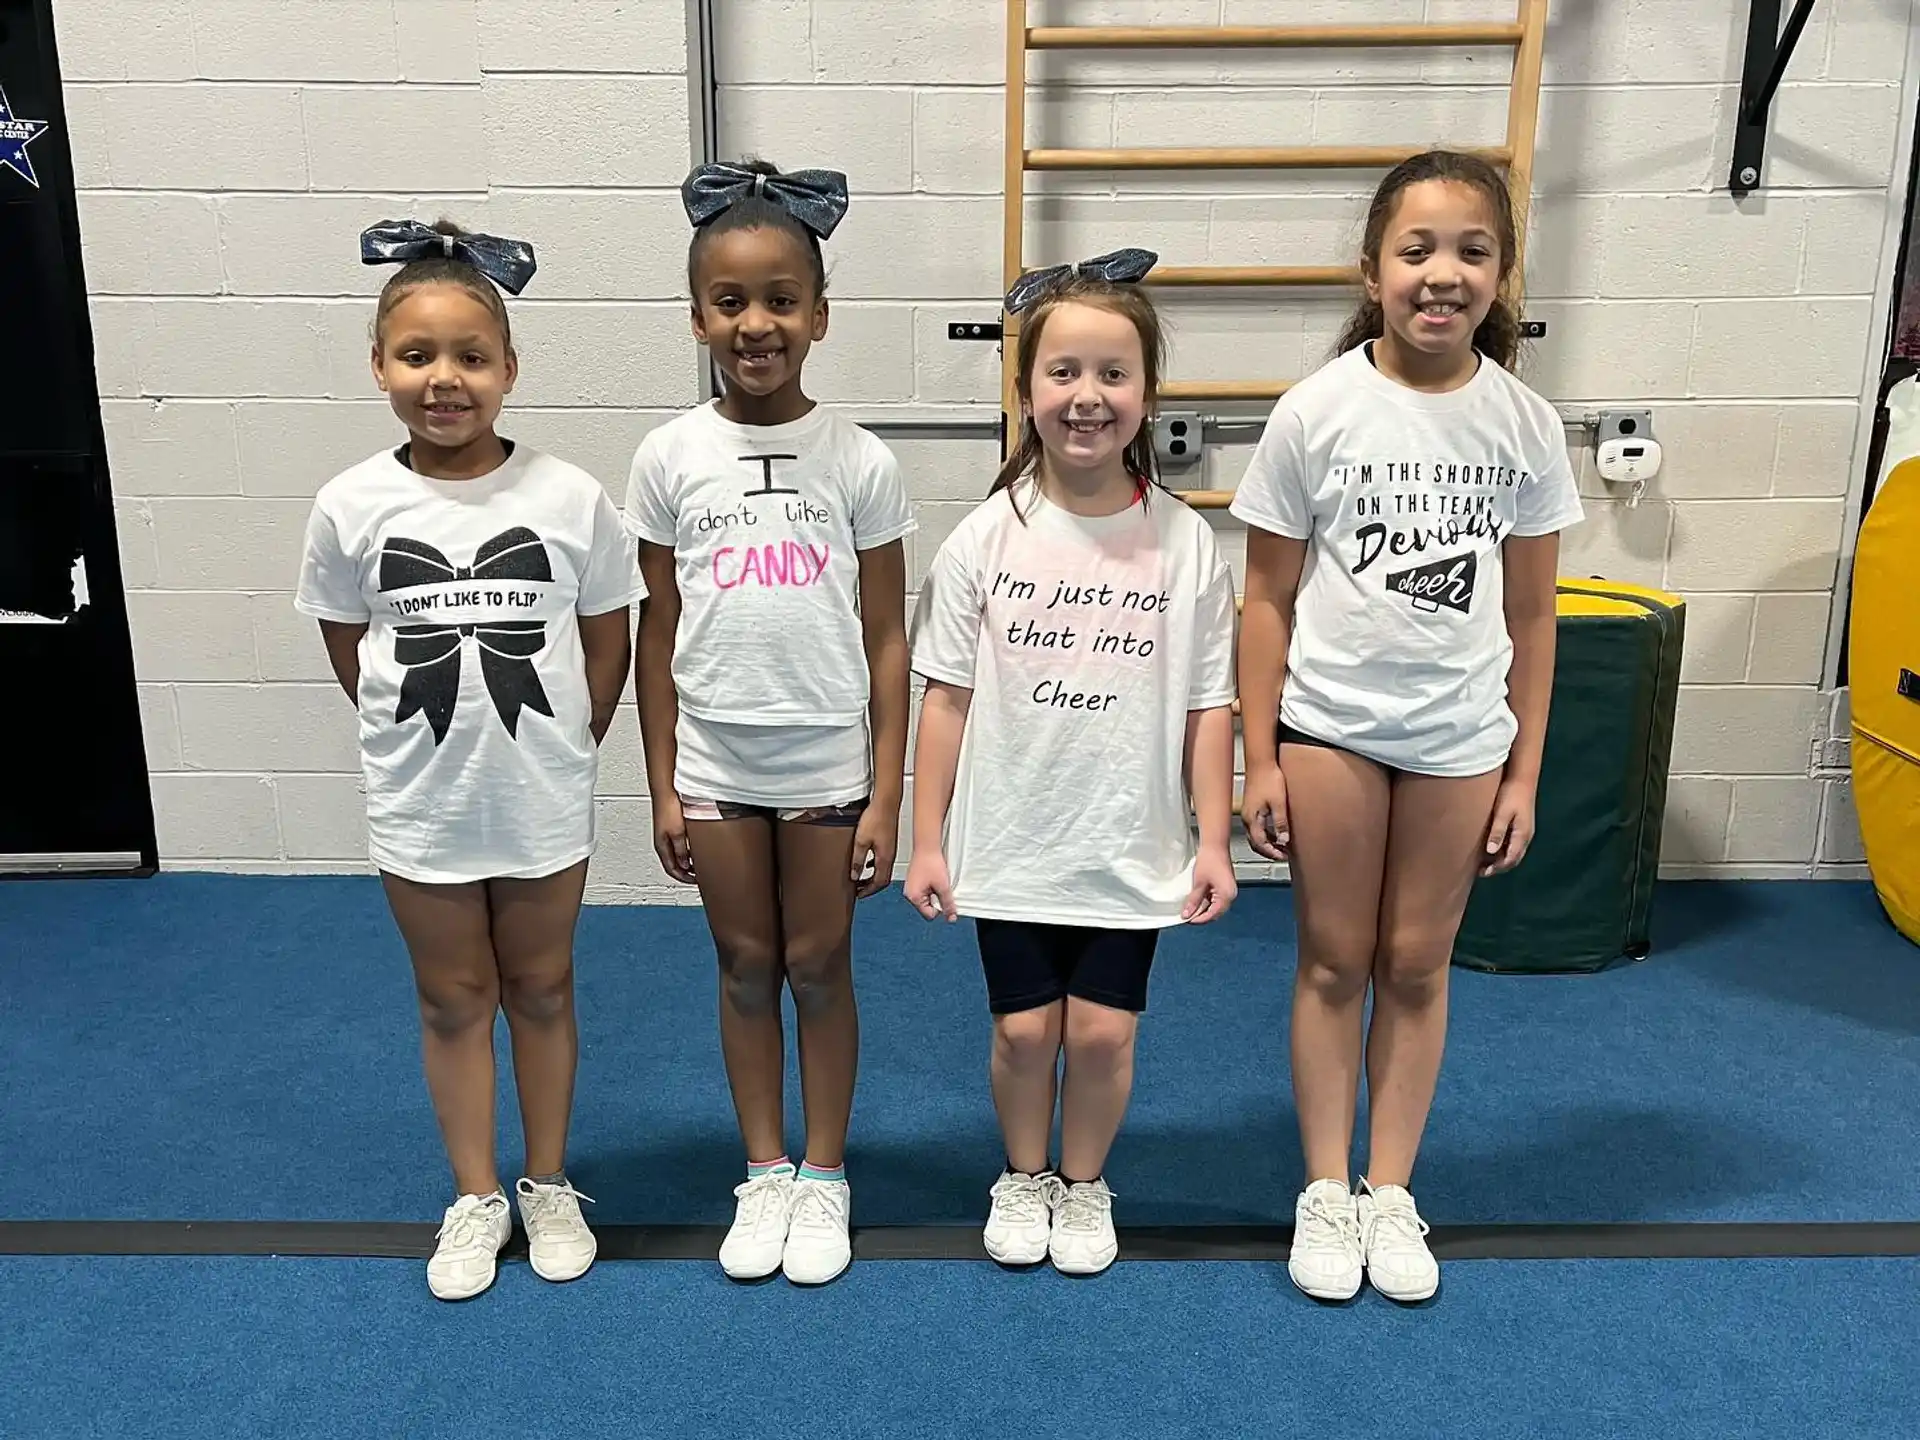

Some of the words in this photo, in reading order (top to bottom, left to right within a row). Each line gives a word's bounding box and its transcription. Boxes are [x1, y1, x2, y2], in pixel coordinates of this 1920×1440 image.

[738, 454, 799, 497] I
[1387, 463, 1421, 482] THE
[1434, 463, 1528, 489] SHORTEST
[698, 502, 758, 532] don't
[785, 500, 829, 523] like
[1357, 496, 1381, 516] ON
[1395, 494, 1430, 514] THE
[1352, 509, 1504, 575] Devious
[713, 540, 830, 590] CANDY
[1397, 560, 1472, 604] cheer
[444, 591, 480, 608] LIKE
[484, 591, 503, 607] TO
[992, 572, 1037, 600] I'm
[1046, 579, 1114, 610] just
[1121, 590, 1171, 613] not
[1006, 619, 1076, 650] that
[1092, 628, 1155, 658] into
[1031, 680, 1118, 712] Cheer
